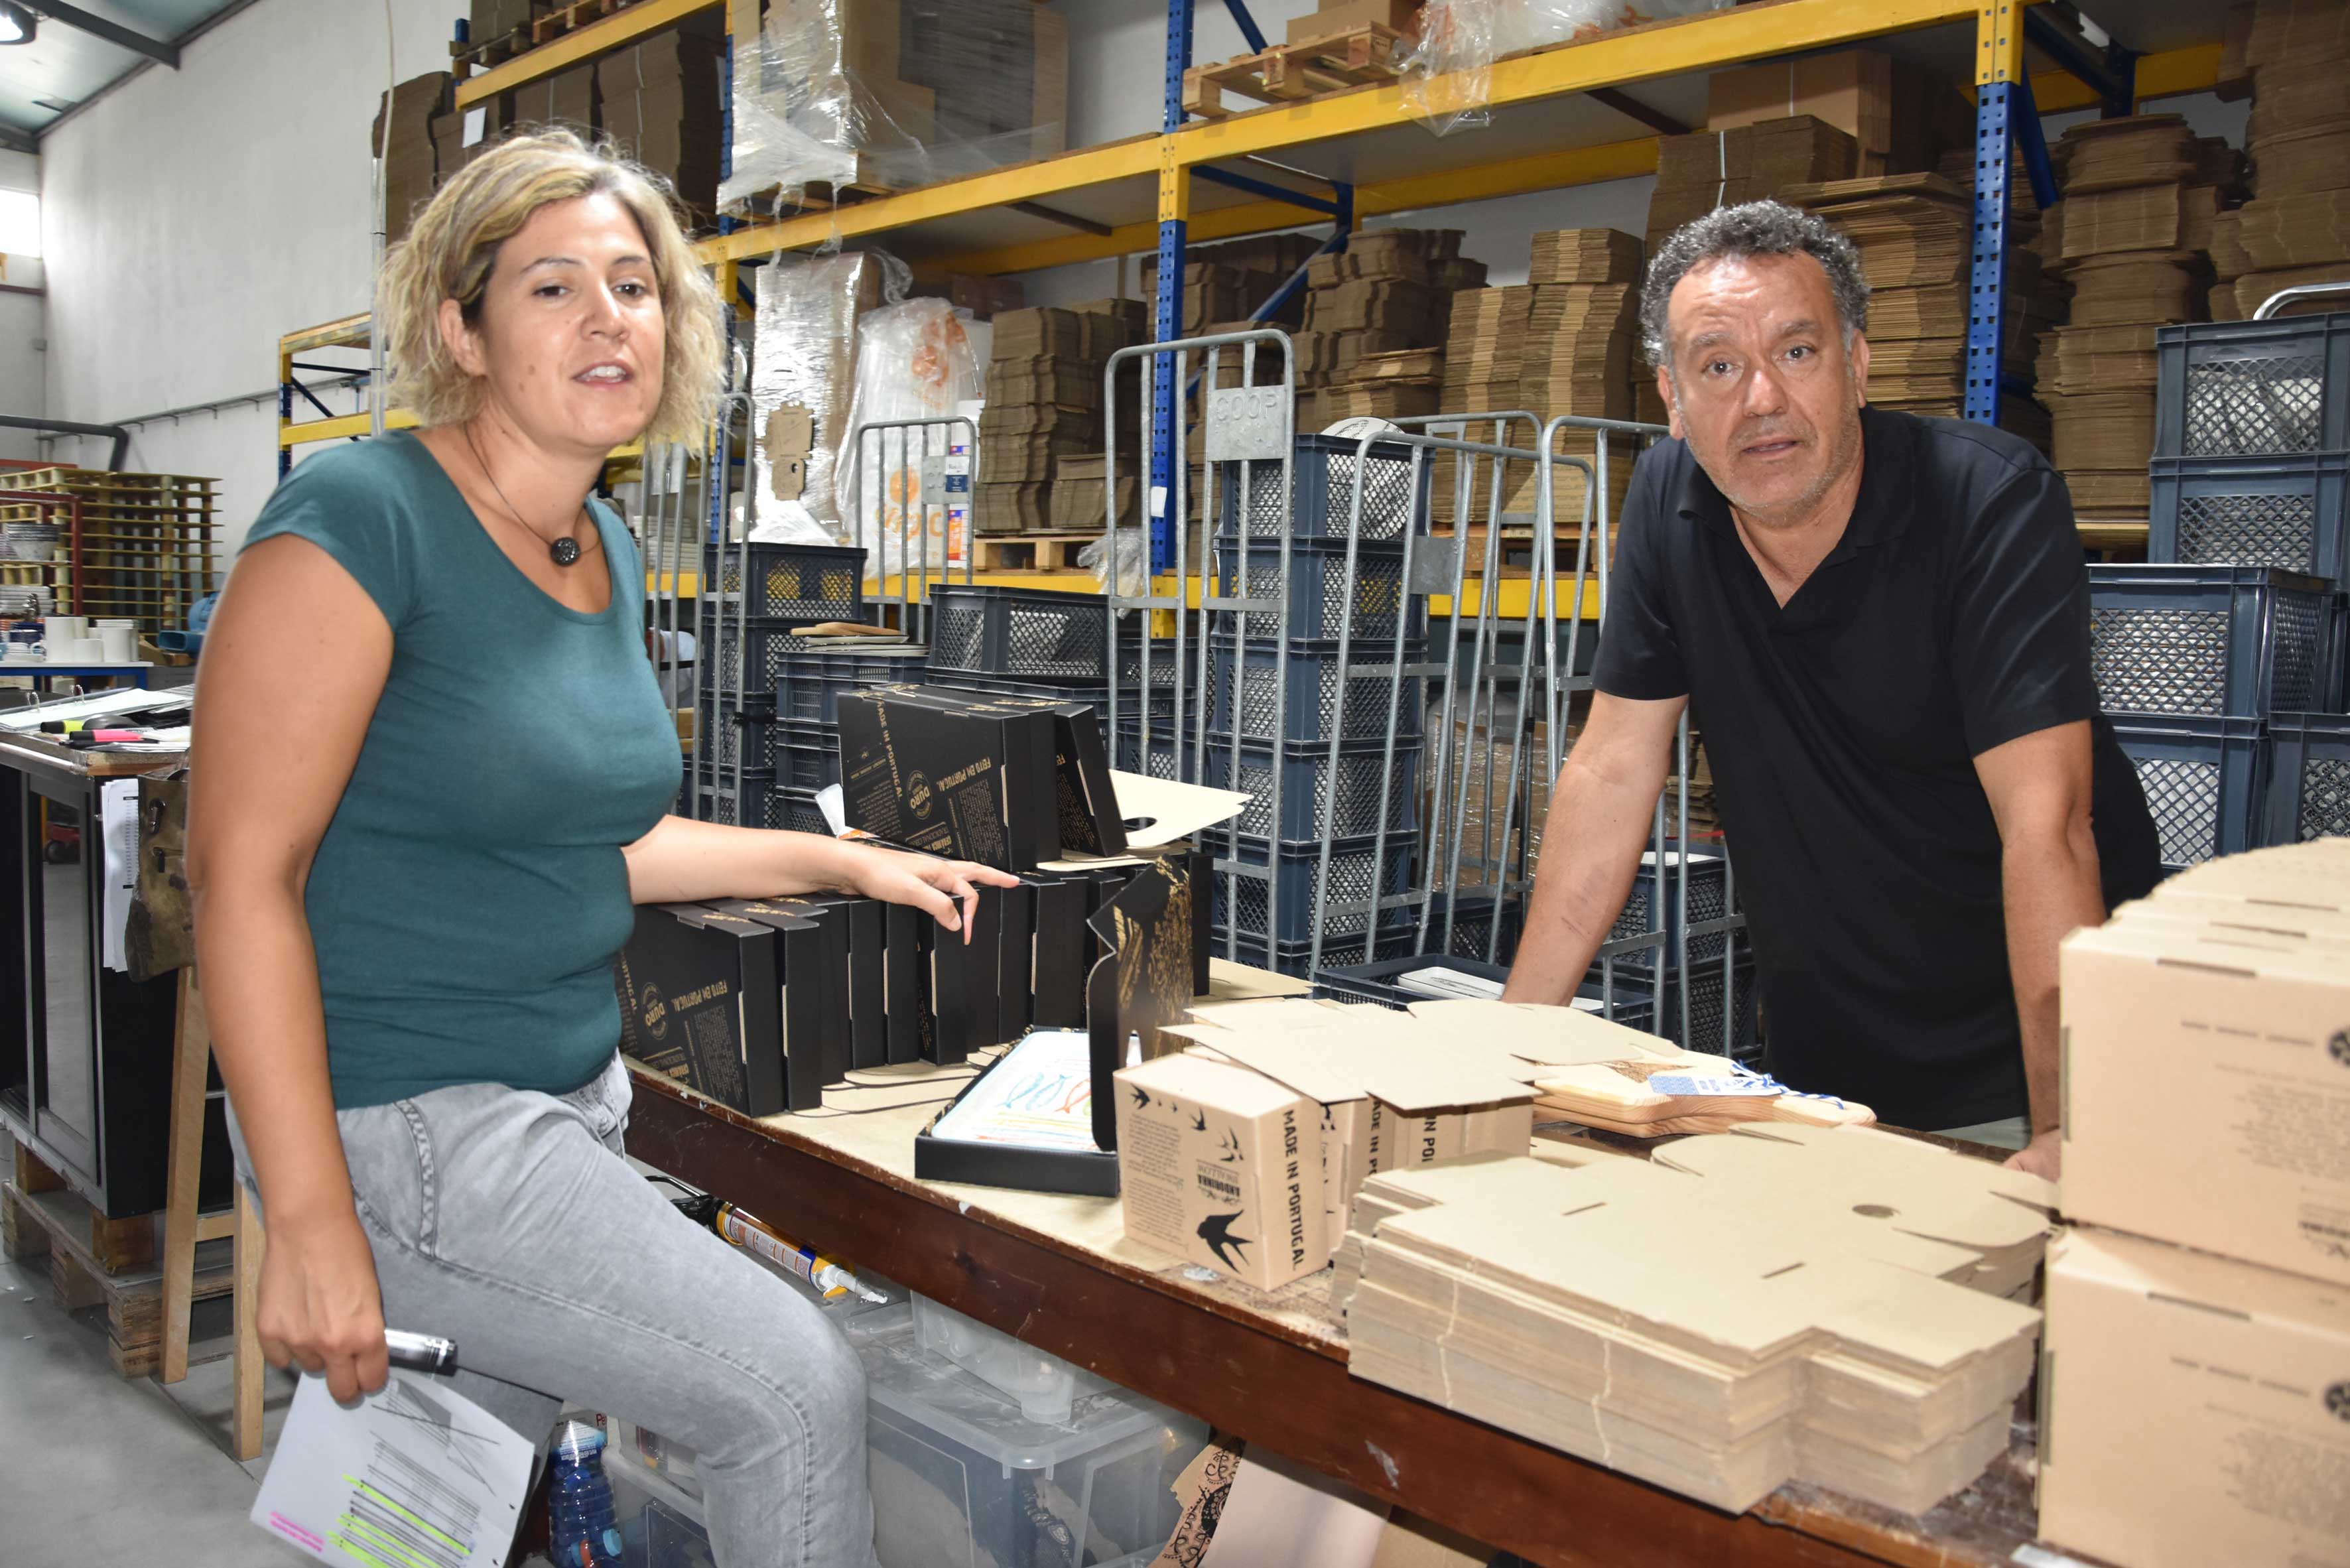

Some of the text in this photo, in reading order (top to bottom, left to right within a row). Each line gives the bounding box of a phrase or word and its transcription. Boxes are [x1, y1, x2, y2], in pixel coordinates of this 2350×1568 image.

[1216, 393, 1277, 421] COOP
[883, 730, 890, 742] IN
[886, 744, 903, 801] PORTUGAL
[966, 765, 976, 777] EM
[975, 757, 992, 773] FEITO
[937, 769, 967, 792] PORTUGAL
[910, 786, 930, 809] DURO
[711, 980, 728, 996] FEITO
[671, 990, 702, 1012] PORTUGAL
[645, 1003, 665, 1026] DURO
[1371, 1098, 1381, 1131] ADE
[1369, 1136, 1379, 1153] IN
[1283, 1110, 1304, 1271] MADE IN PORTUGAL
